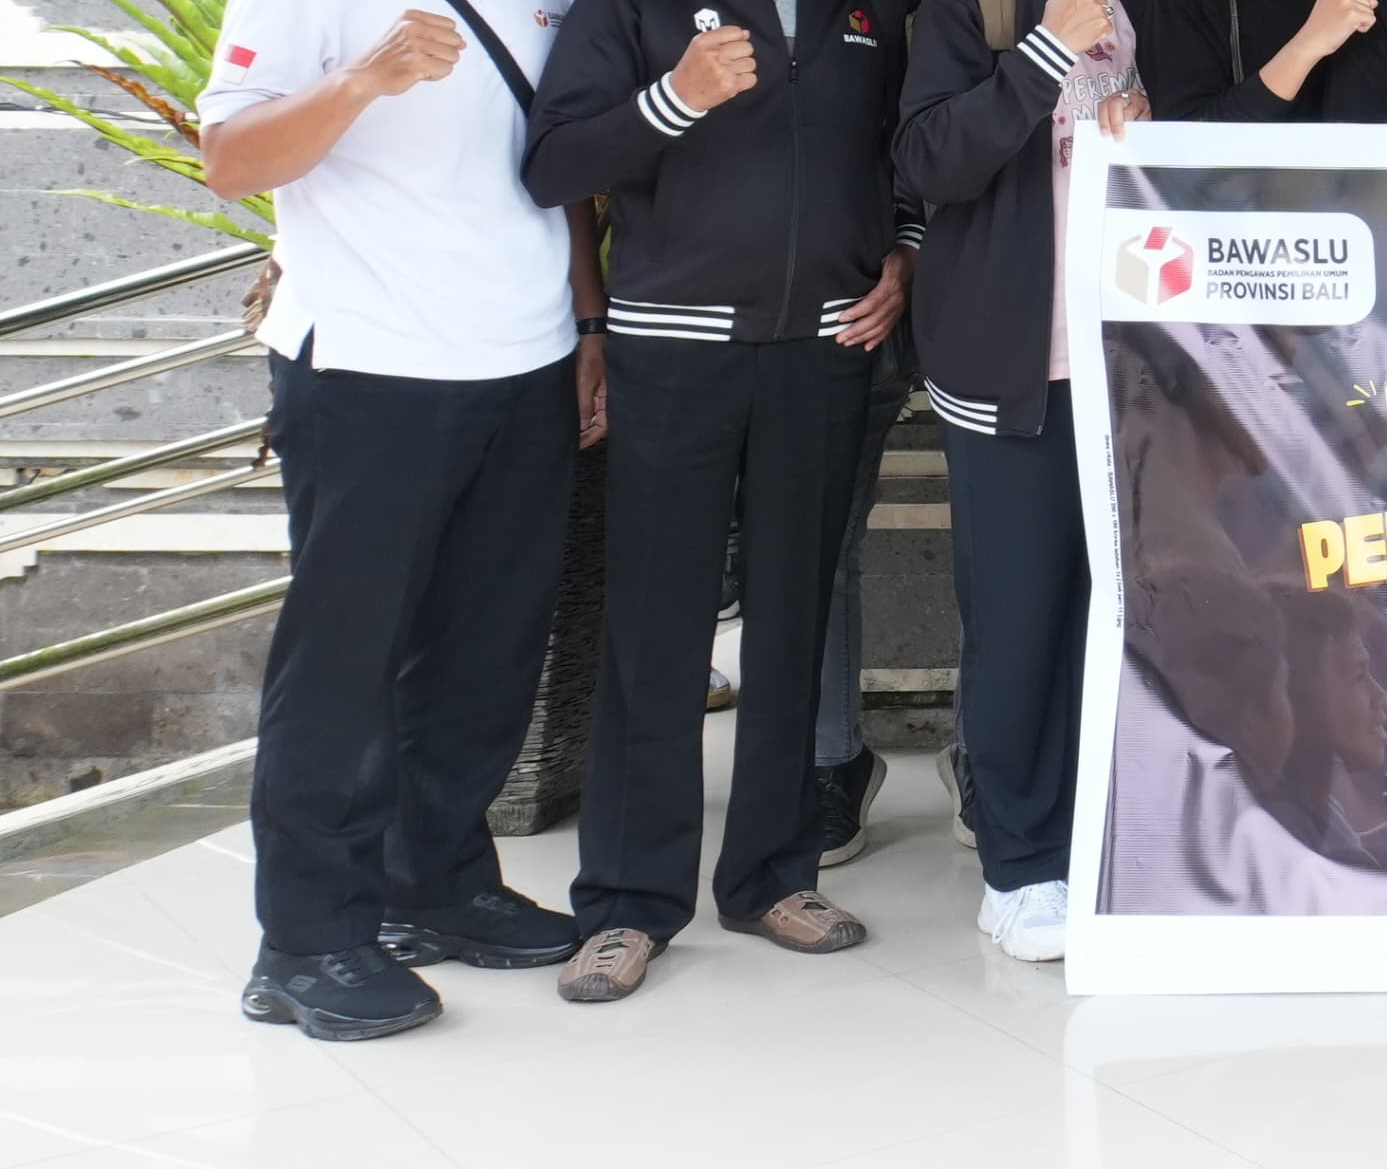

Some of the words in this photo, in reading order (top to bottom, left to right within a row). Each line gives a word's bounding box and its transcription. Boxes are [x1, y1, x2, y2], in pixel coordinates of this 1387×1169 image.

[1207, 237, 1349, 265] BAWASLU
[1206, 281, 1296, 300] PROVINSI
[1302, 282, 1349, 300] BALI
